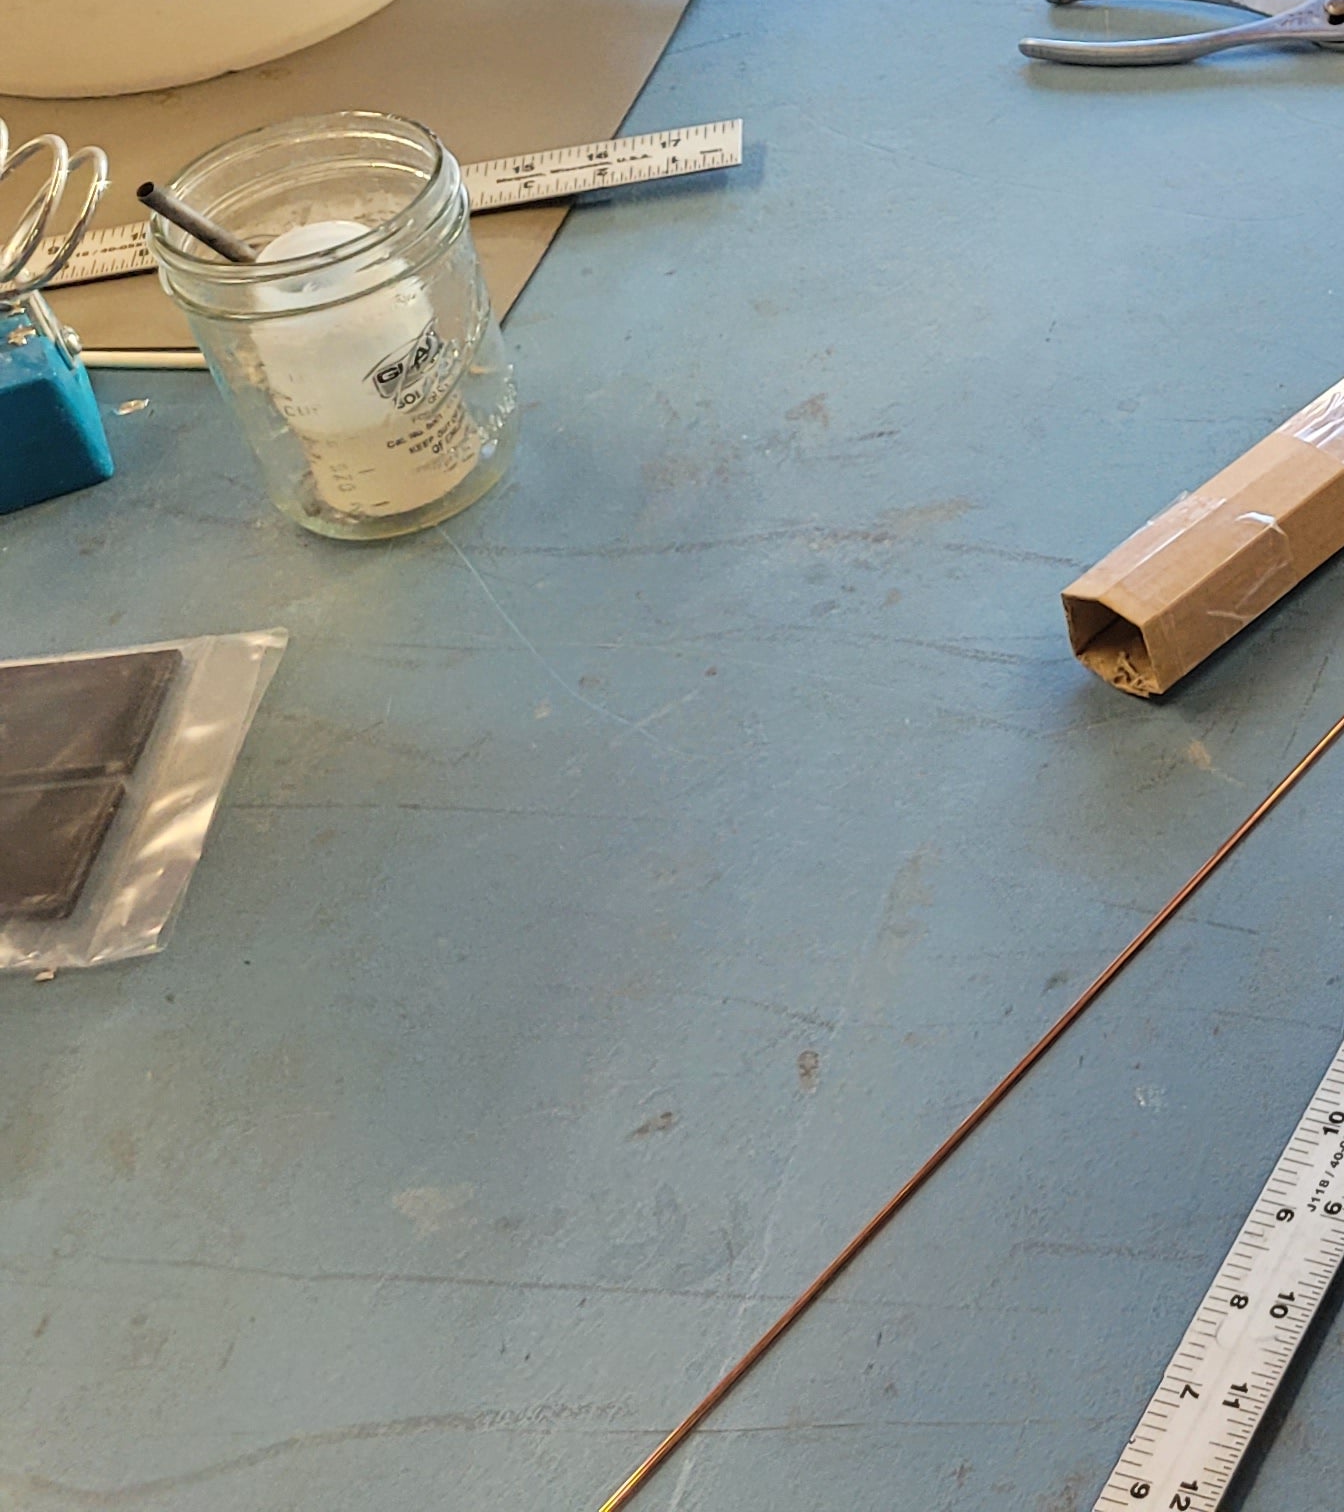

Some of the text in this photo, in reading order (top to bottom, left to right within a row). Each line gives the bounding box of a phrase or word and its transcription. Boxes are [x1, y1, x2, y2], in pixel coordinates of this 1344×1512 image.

[1275, 1208, 1296, 1224] 9
[1229, 1293, 1250, 1310] 8
[1269, 1290, 1296, 1320] 10
[1179, 1383, 1200, 1400] 7
[1221, 1381, 1249, 1410] 11
[1168, 1479, 1200, 1512] 12
